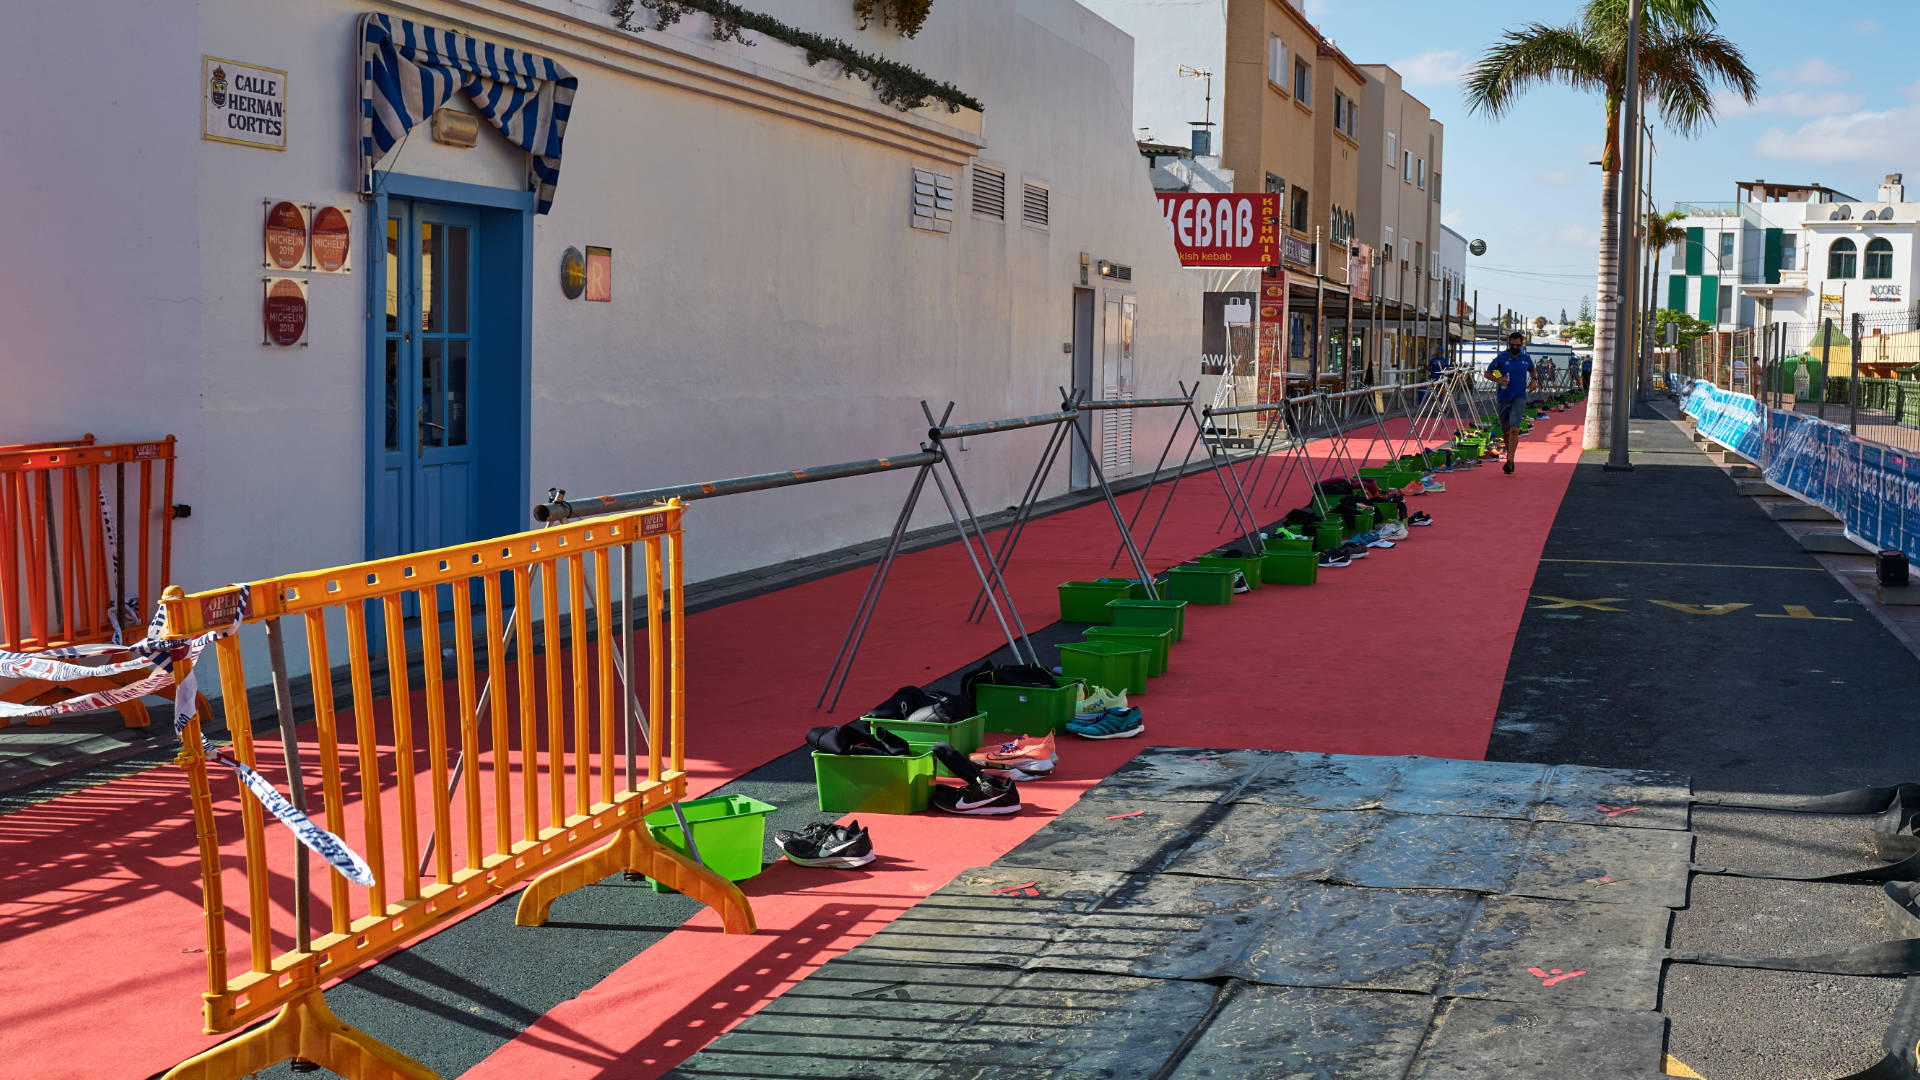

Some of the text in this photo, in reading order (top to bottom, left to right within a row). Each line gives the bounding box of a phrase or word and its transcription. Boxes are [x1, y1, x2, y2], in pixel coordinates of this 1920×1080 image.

[235, 74, 276, 96] CALLE
[1259, 197, 1274, 262] KASHMIR
[269, 234, 304, 246] MICHELIN
[314, 238, 347, 249] MICHELIN
[1178, 251, 1232, 261] kish kebab
[269, 312, 304, 323] MICHELIN
